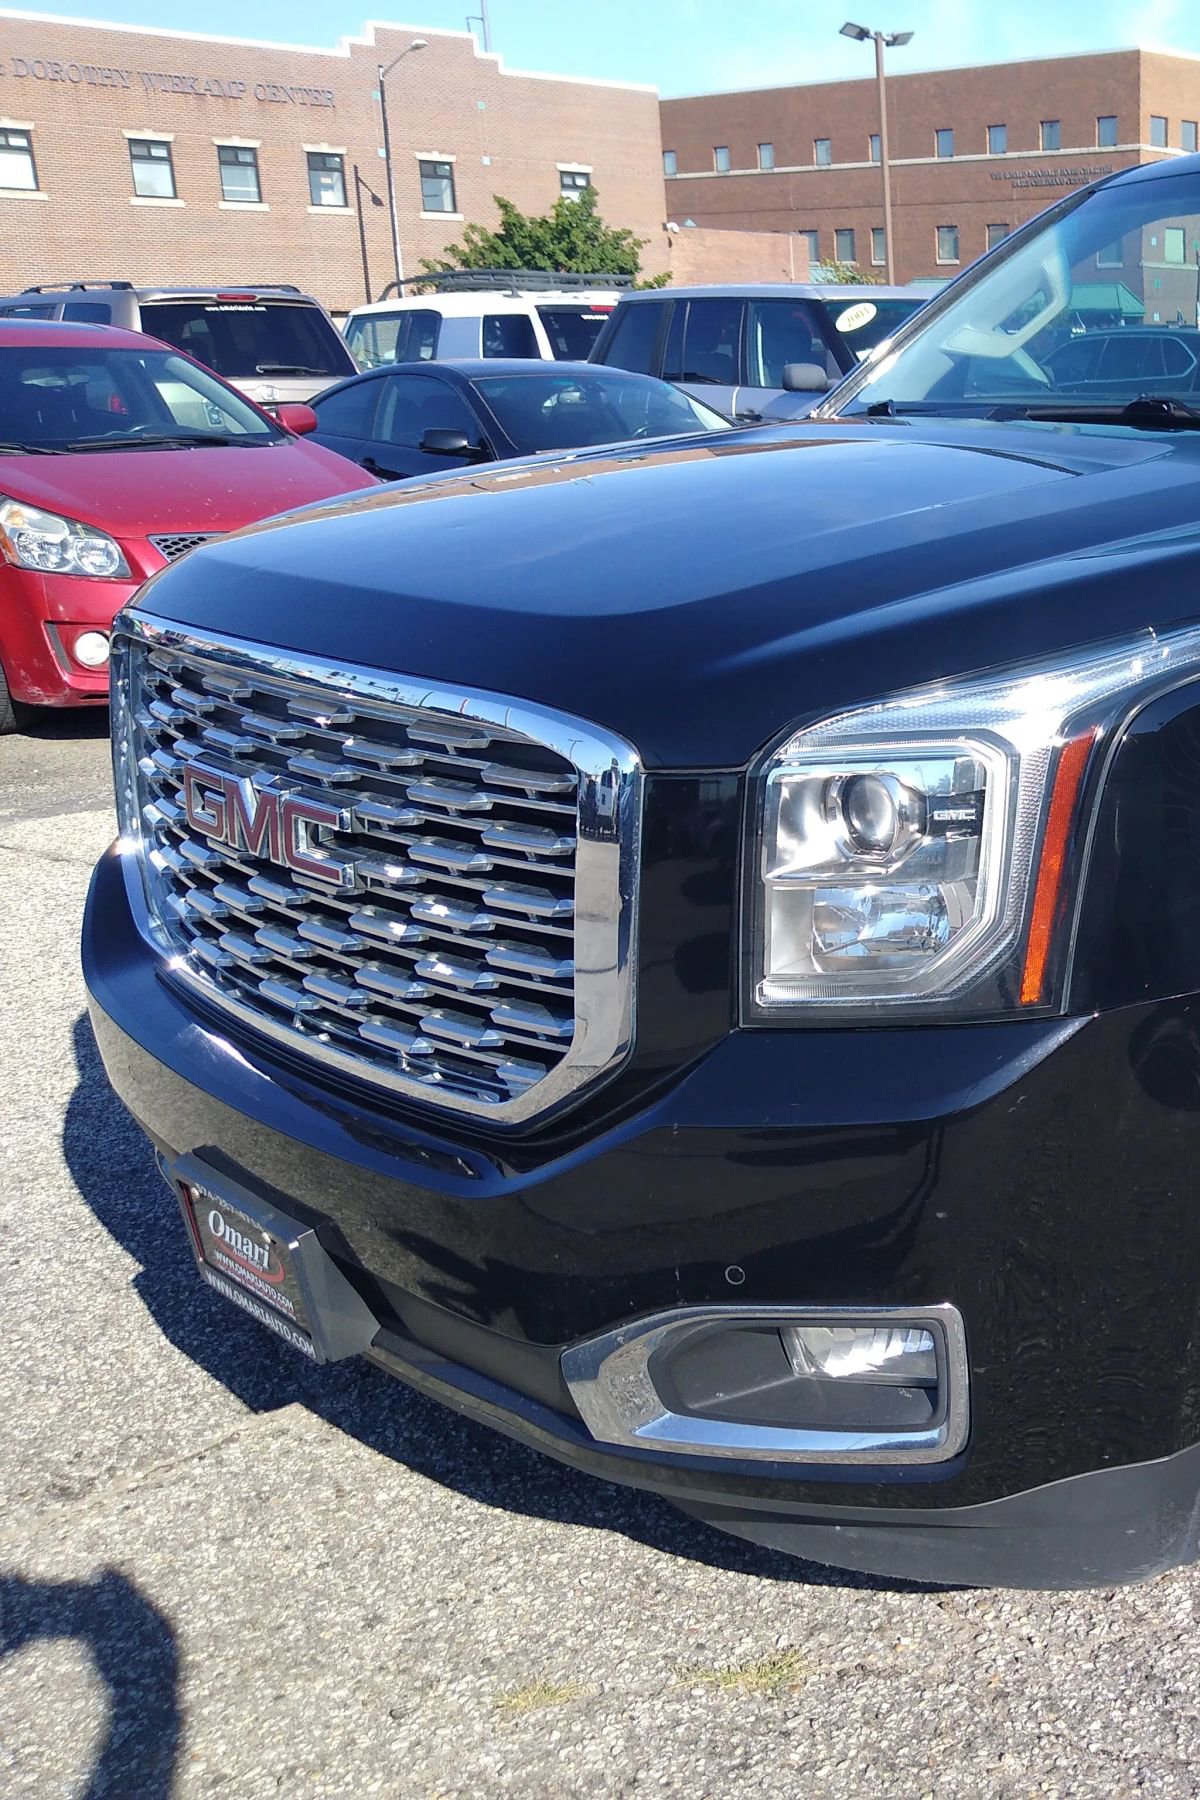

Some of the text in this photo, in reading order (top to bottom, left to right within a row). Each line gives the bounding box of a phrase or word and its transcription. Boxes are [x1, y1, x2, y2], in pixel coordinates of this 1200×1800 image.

[11, 58, 132, 89] DOROTHY
[136, 71, 247, 100] WIEKAMP
[254, 82, 336, 108] CENTER
[184, 759, 353, 888] GMC
[933, 808, 976, 821] GMC
[208, 1210, 270, 1270] Omari
